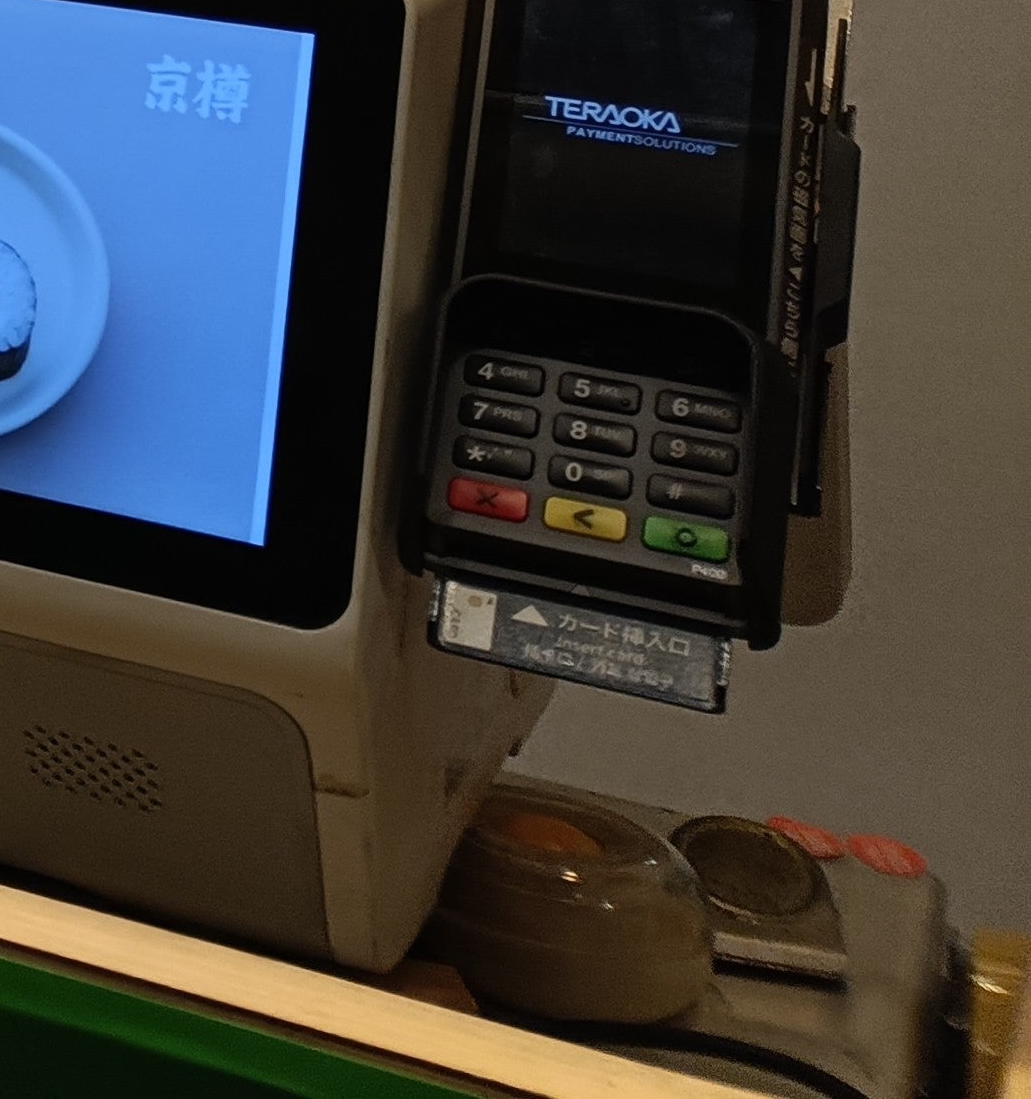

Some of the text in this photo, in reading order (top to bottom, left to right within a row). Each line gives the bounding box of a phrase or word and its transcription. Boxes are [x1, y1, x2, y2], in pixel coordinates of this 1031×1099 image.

[143, 53, 253, 125] 京樽
[544, 94, 682, 134] TERAOKA
[477, 362, 496, 381] 4
[573, 378, 592, 399] 5
[471, 401, 489, 421] 7
[671, 397, 691, 418] 6
[569, 420, 589, 441] 8
[668, 438, 688, 460] 9
[564, 461, 584, 483] 0
